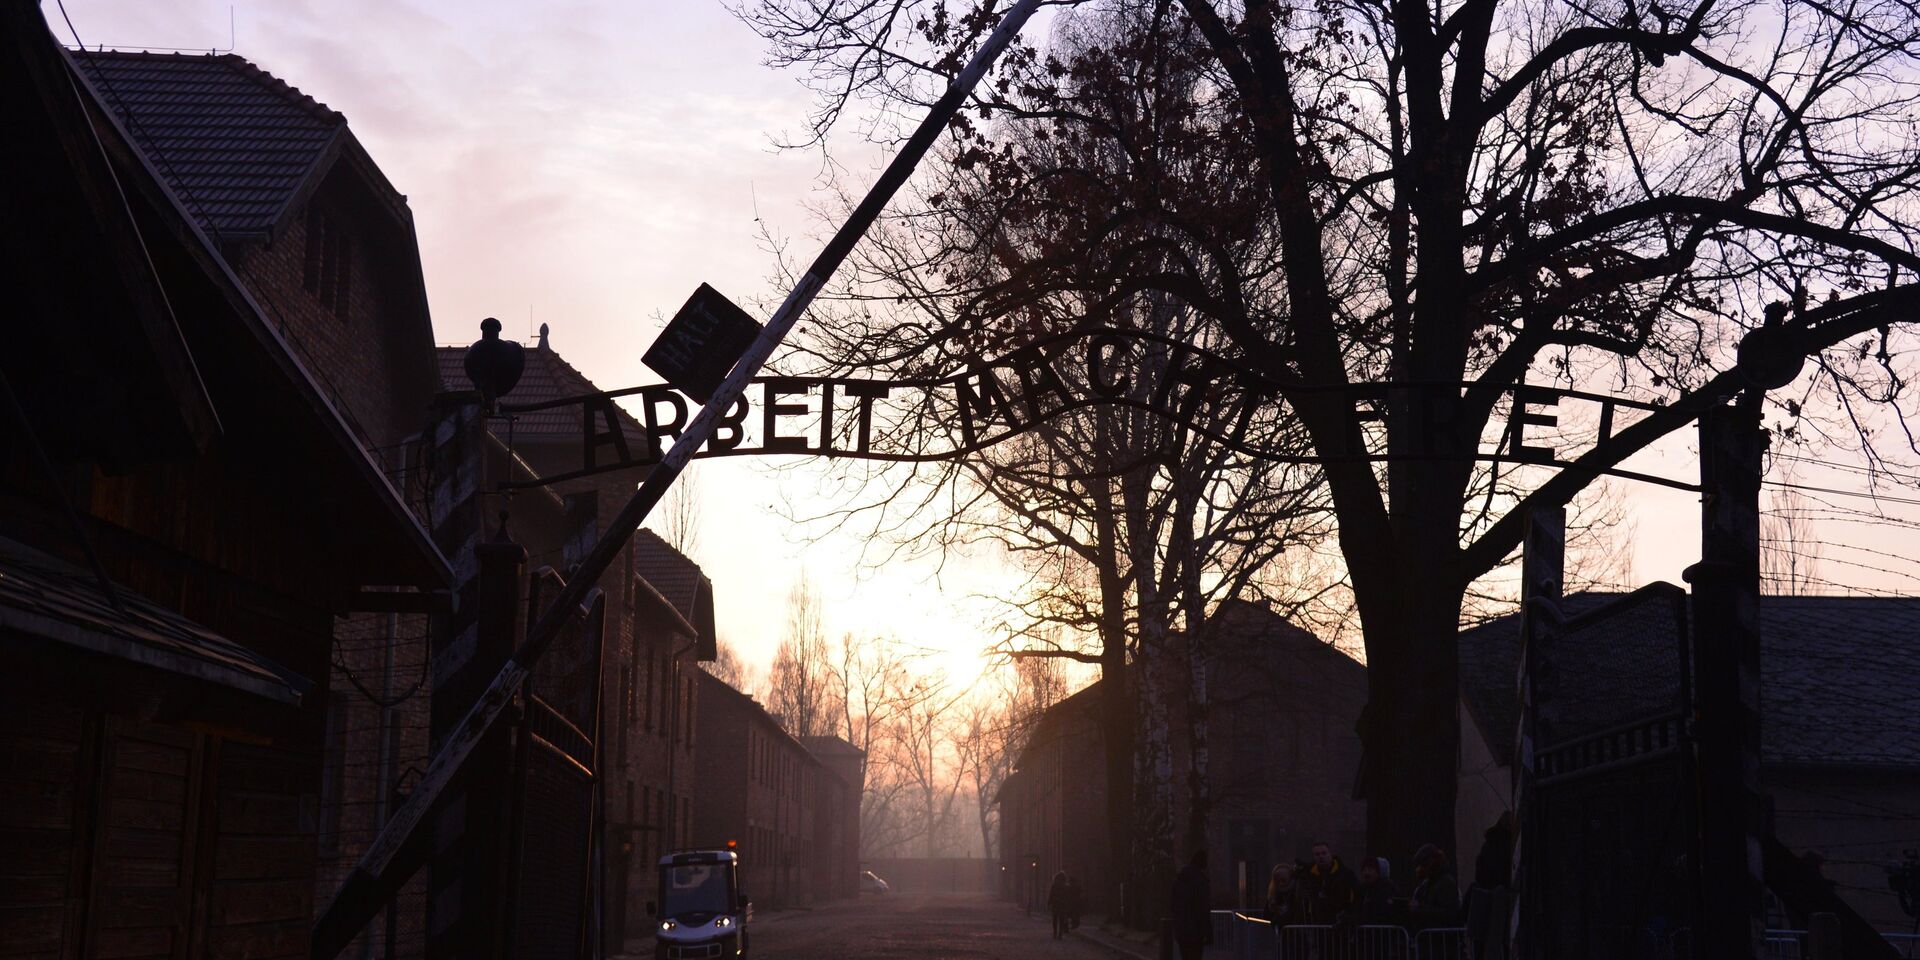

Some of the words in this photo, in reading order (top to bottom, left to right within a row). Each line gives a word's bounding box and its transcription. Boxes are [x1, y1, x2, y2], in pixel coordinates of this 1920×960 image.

[656, 297, 720, 371] HALT
[584, 379, 889, 471] ARBEIT
[954, 334, 1277, 448] MACHT
[1346, 386, 1614, 467] FREI
